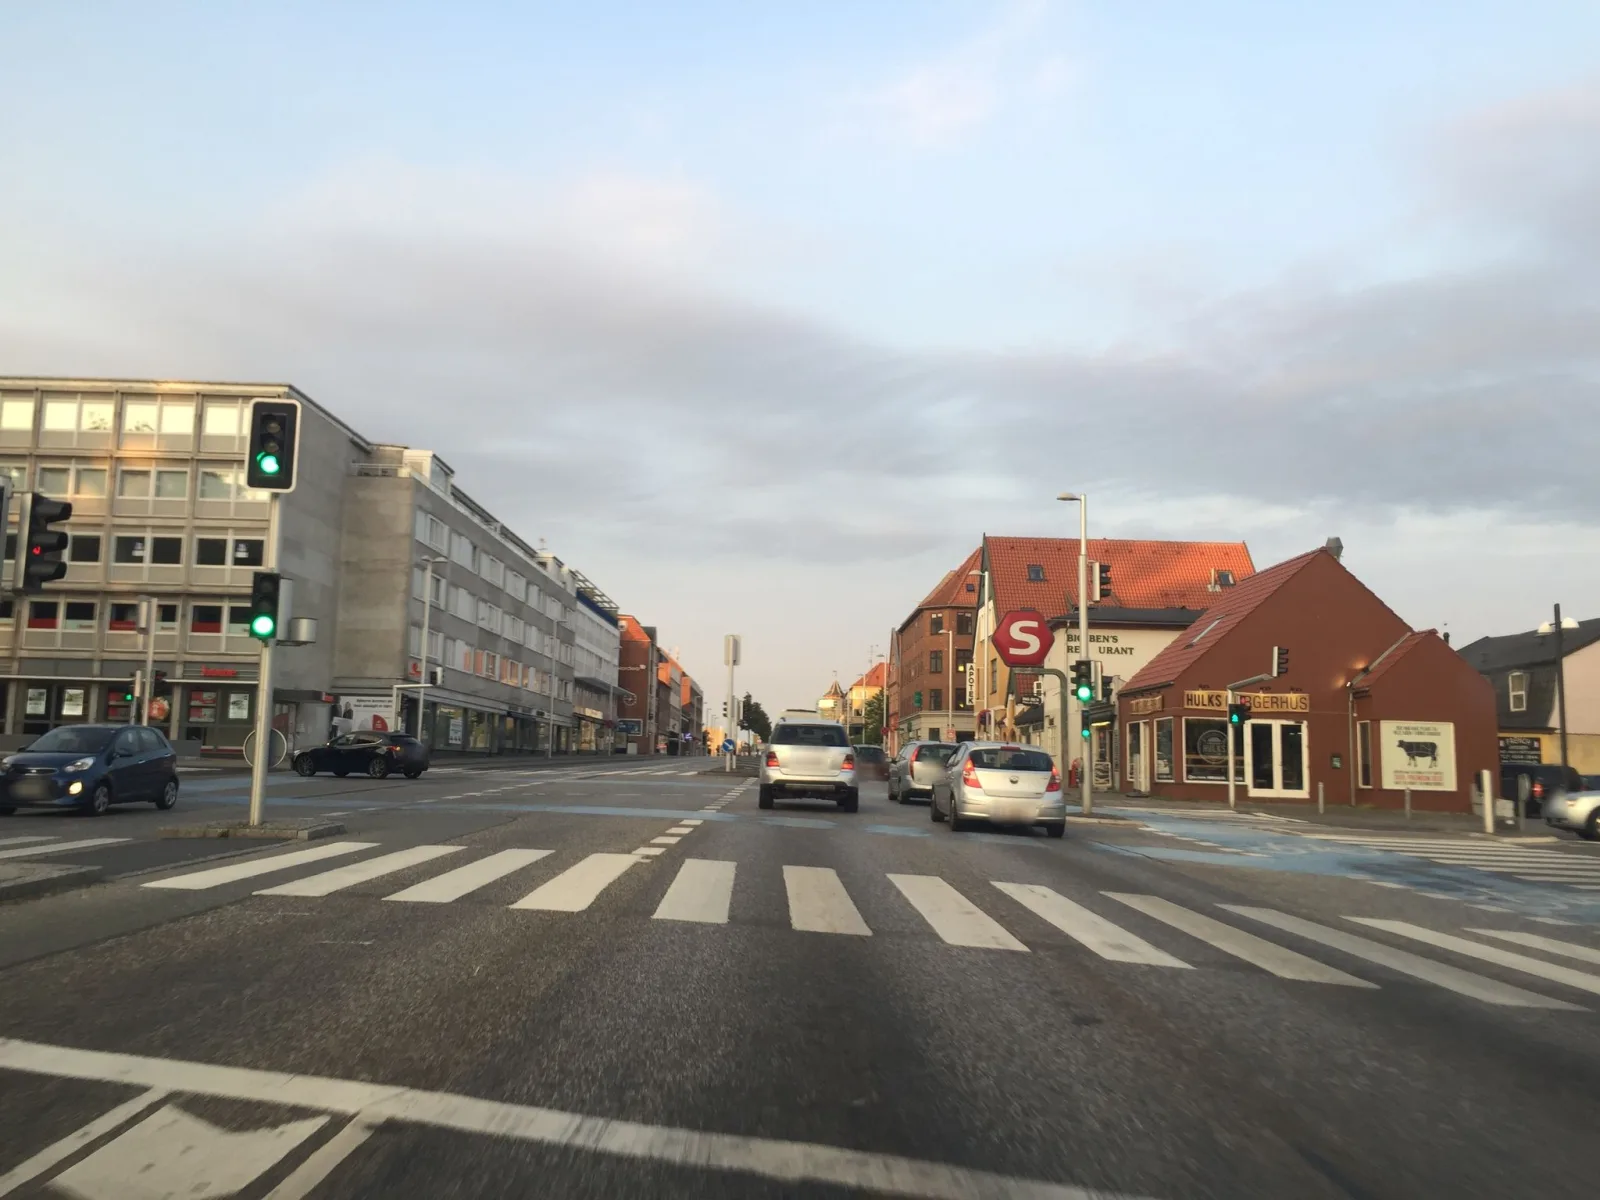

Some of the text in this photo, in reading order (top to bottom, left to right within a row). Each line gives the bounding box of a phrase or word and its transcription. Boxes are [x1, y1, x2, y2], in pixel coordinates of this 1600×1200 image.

[1009, 620, 1040, 656] S
[1089, 635, 1119, 643] BEN'S
[1186, 694, 1222, 707] HULKS
